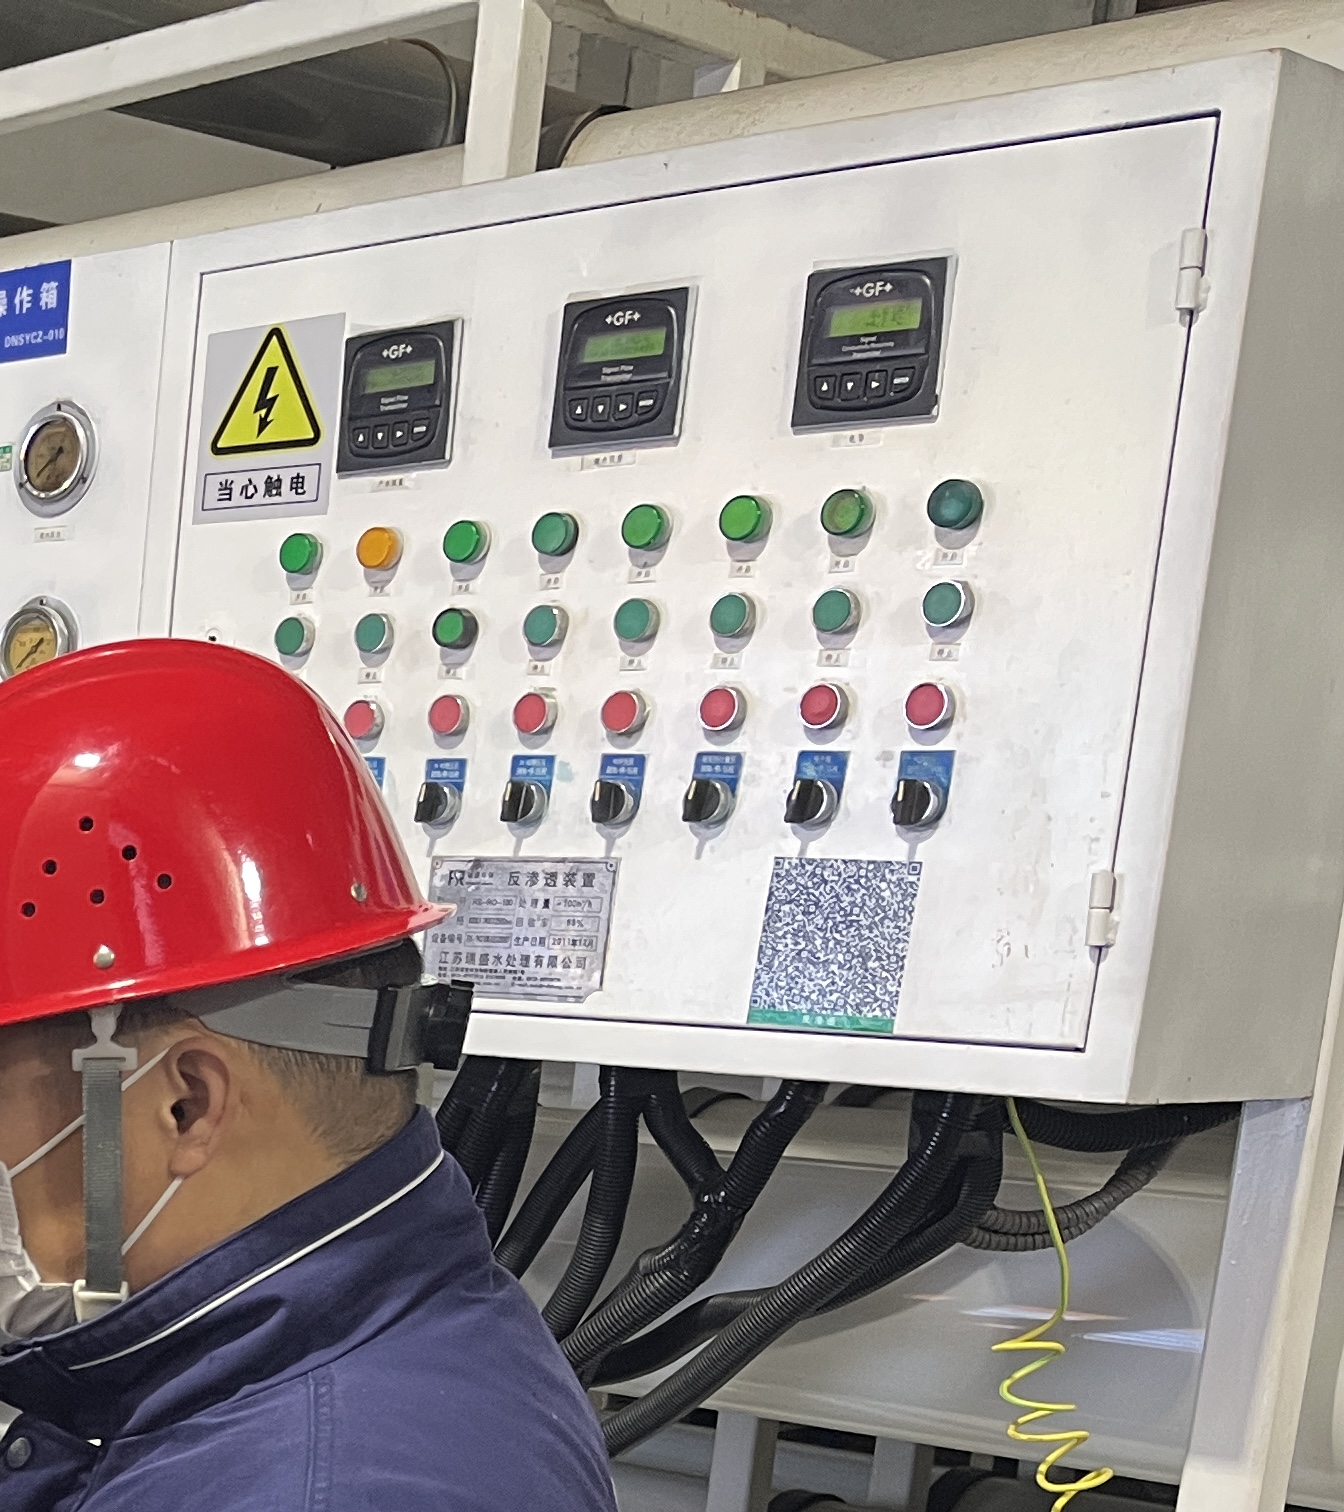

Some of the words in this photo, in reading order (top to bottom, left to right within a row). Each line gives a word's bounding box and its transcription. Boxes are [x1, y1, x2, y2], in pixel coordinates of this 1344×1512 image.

[215, 472, 308, 503] 当心触电
[507, 870, 597, 889] 反渗透装置
[513, 935, 547, 948] 生产日期
